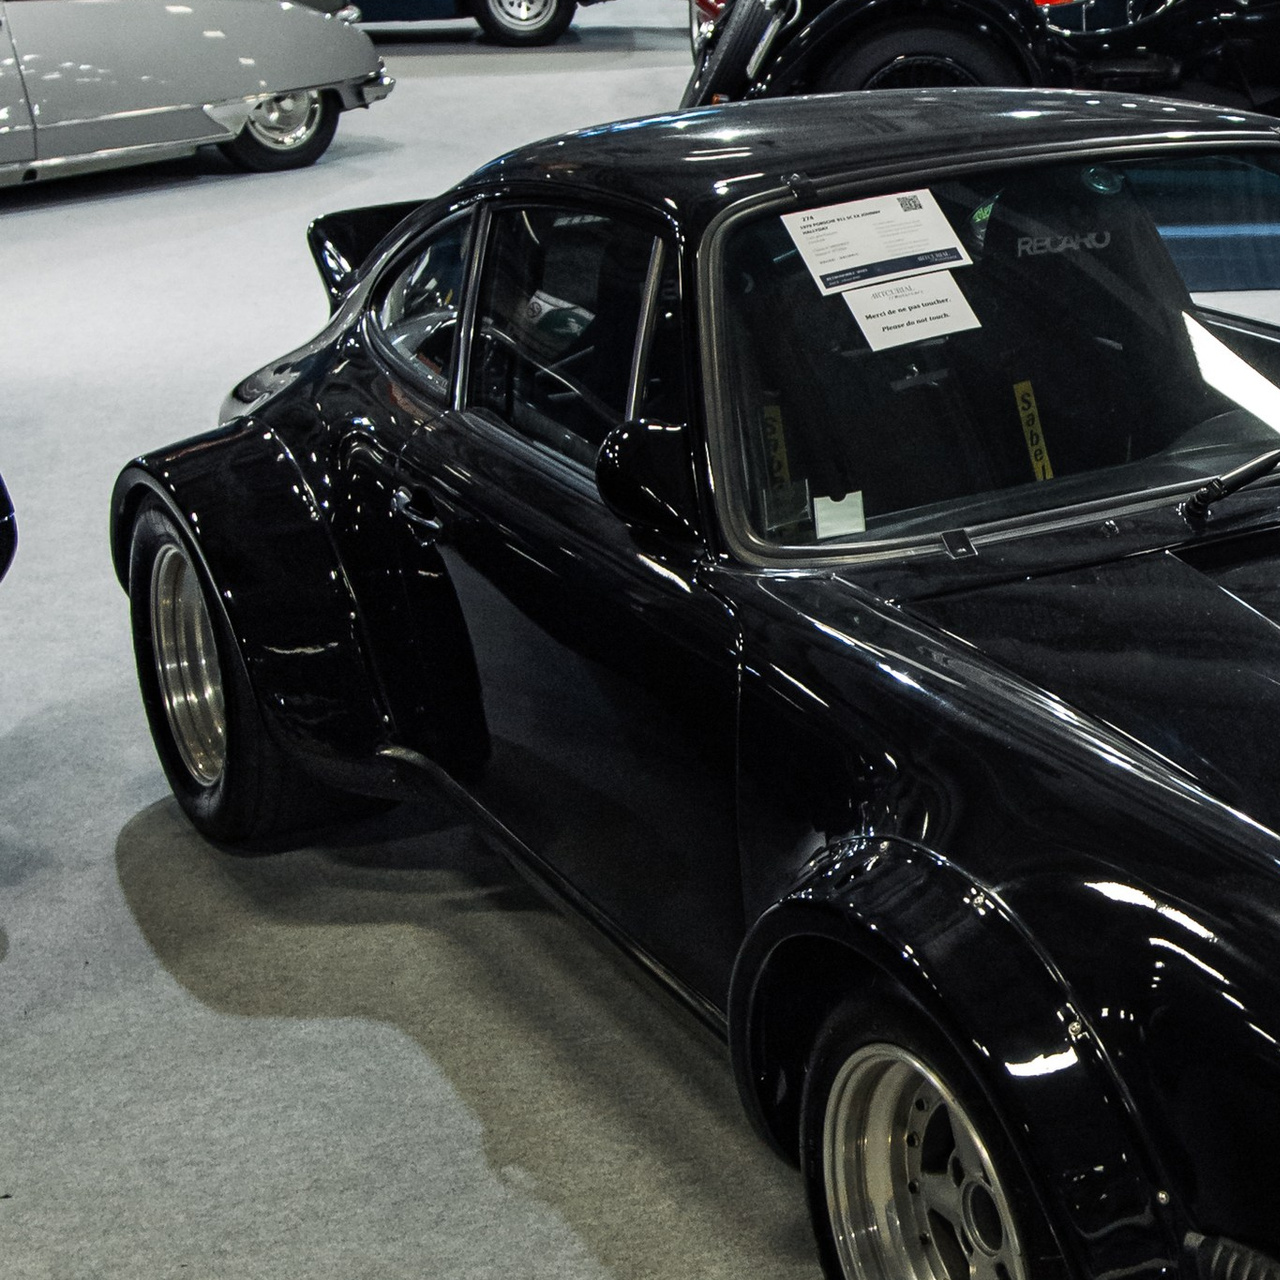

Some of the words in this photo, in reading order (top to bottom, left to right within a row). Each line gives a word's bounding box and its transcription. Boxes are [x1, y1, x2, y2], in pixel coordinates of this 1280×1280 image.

[865, 311, 886, 321] Merci
[887, 308, 896, 316] de
[908, 303, 921, 312] pas
[882, 322, 905, 333] Please
[906, 319, 915, 327] do
[916, 316, 928, 324] not
